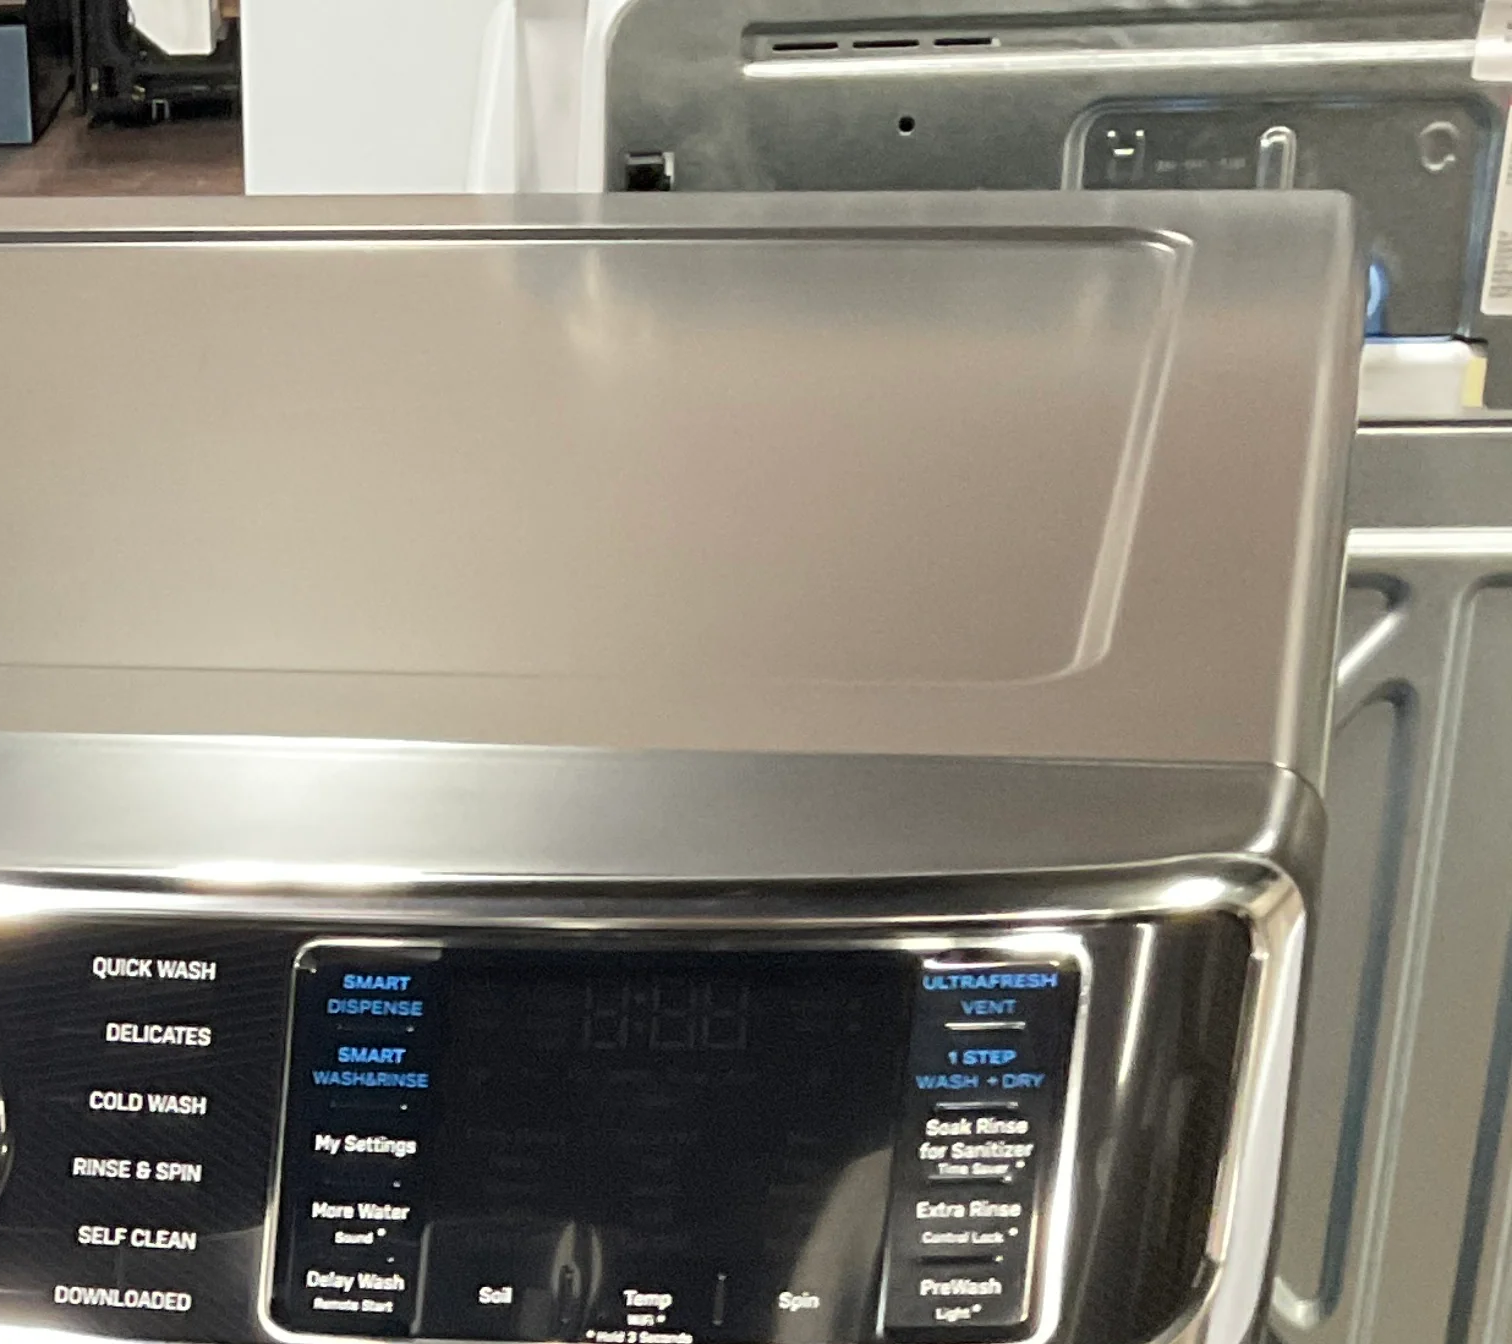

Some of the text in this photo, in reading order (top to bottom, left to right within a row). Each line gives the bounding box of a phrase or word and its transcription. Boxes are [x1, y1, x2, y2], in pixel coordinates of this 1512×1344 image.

[92, 956, 217, 981] QUICK WASH
[343, 975, 411, 991] SMART
[923, 972, 1058, 991] ULTRAFRESH
[327, 999, 423, 1016] DISPENSE
[960, 999, 1017, 1015] VENT
[106, 1023, 212, 1047] DELICATES
[338, 1048, 406, 1064] SMART
[948, 1049, 1017, 1065] 1 STEP
[312, 1071, 429, 1089] WASH&RINSE
[915, 1073, 980, 1090] WASH
[1002, 1073, 1045, 1089] DRY
[89, 1091, 208, 1115] COLD WASH
[925, 1117, 1029, 1136] Soak Rinse
[315, 1135, 417, 1157] My Settings
[919, 1140, 1034, 1160] for Sanitizer
[73, 1158, 202, 1183] RINSE & SPIN
[312, 1201, 410, 1219] More Water
[916, 1200, 1022, 1218] Extra Rinse
[77, 1226, 197, 1250] SELF CLEAN
[307, 1270, 405, 1293] Delay Wash
[920, 1277, 1002, 1296] PreWash
[54, 1286, 192, 1312] DOWNLOADED
[479, 1286, 513, 1305] Soil
[623, 1289, 673, 1311] Temp
[778, 1291, 820, 1312] Spin
